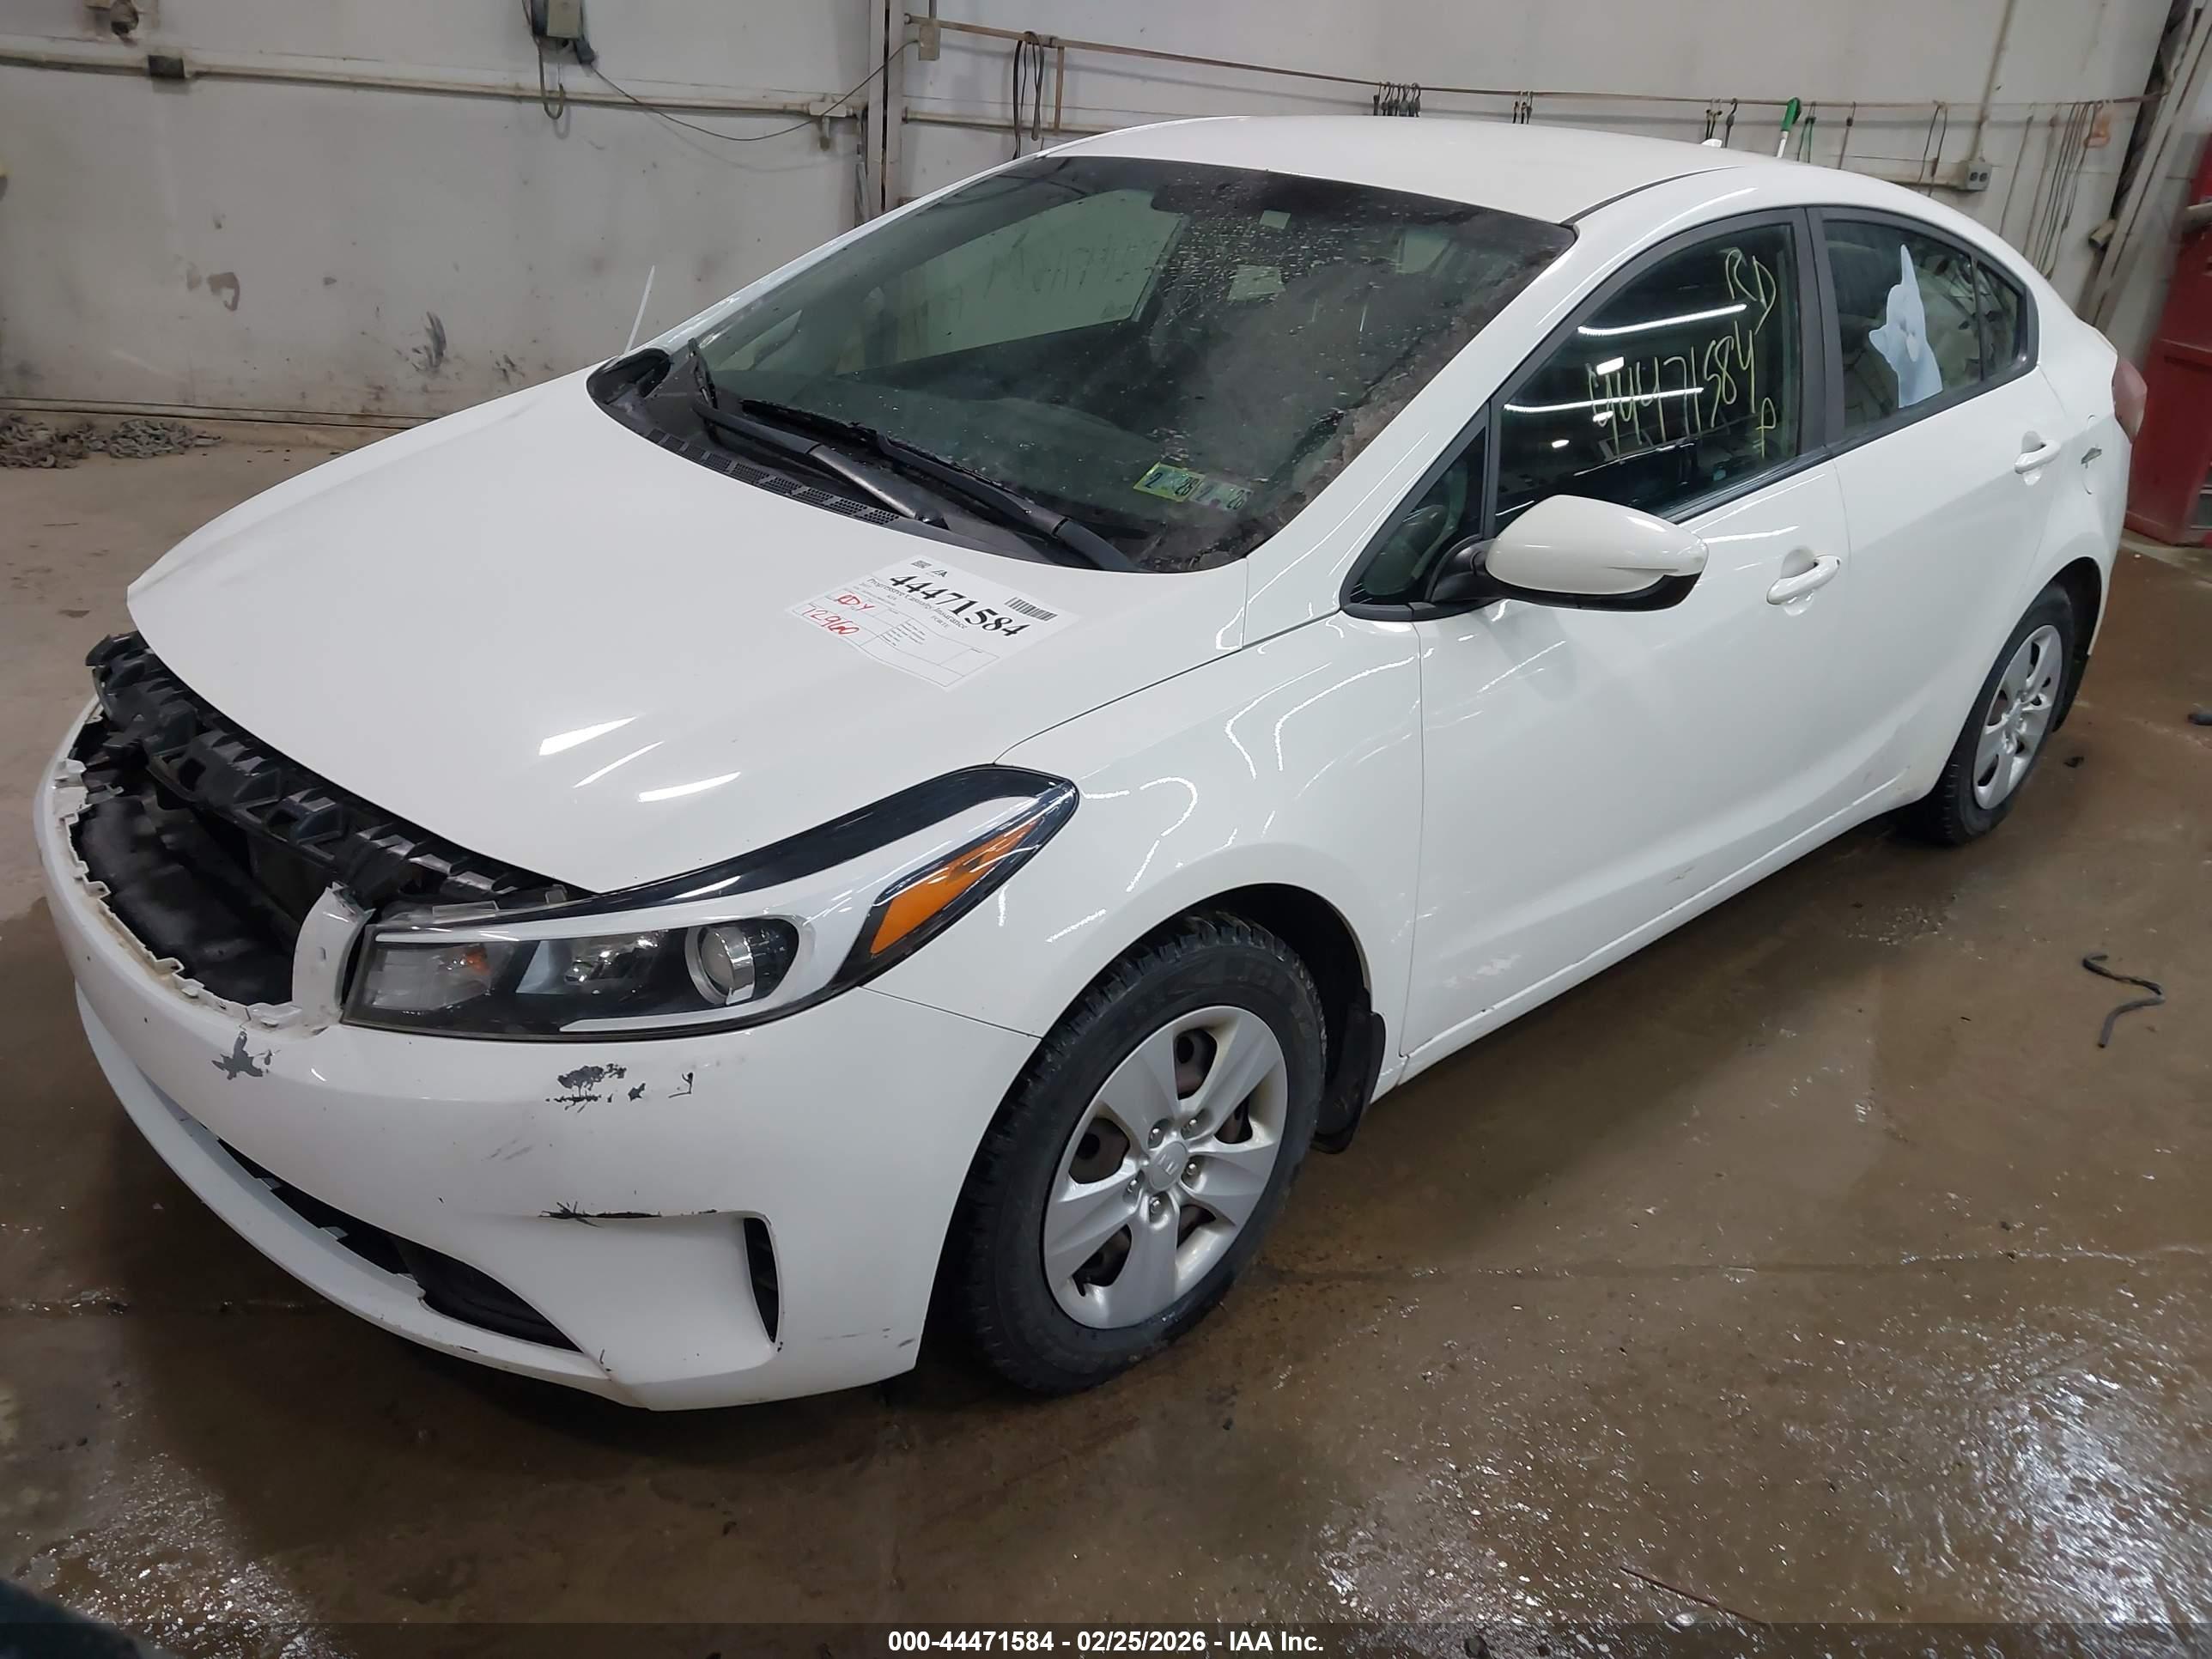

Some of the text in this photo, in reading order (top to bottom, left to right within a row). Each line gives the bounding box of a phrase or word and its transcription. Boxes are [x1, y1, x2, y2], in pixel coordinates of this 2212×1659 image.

[1585, 319, 1757, 462] 44471584
[1144, 471, 1164, 489] 2
[866, 578, 908, 598] Progressive
[933, 607, 968, 629] Insurance
[889, 574, 1030, 637] 44471584
